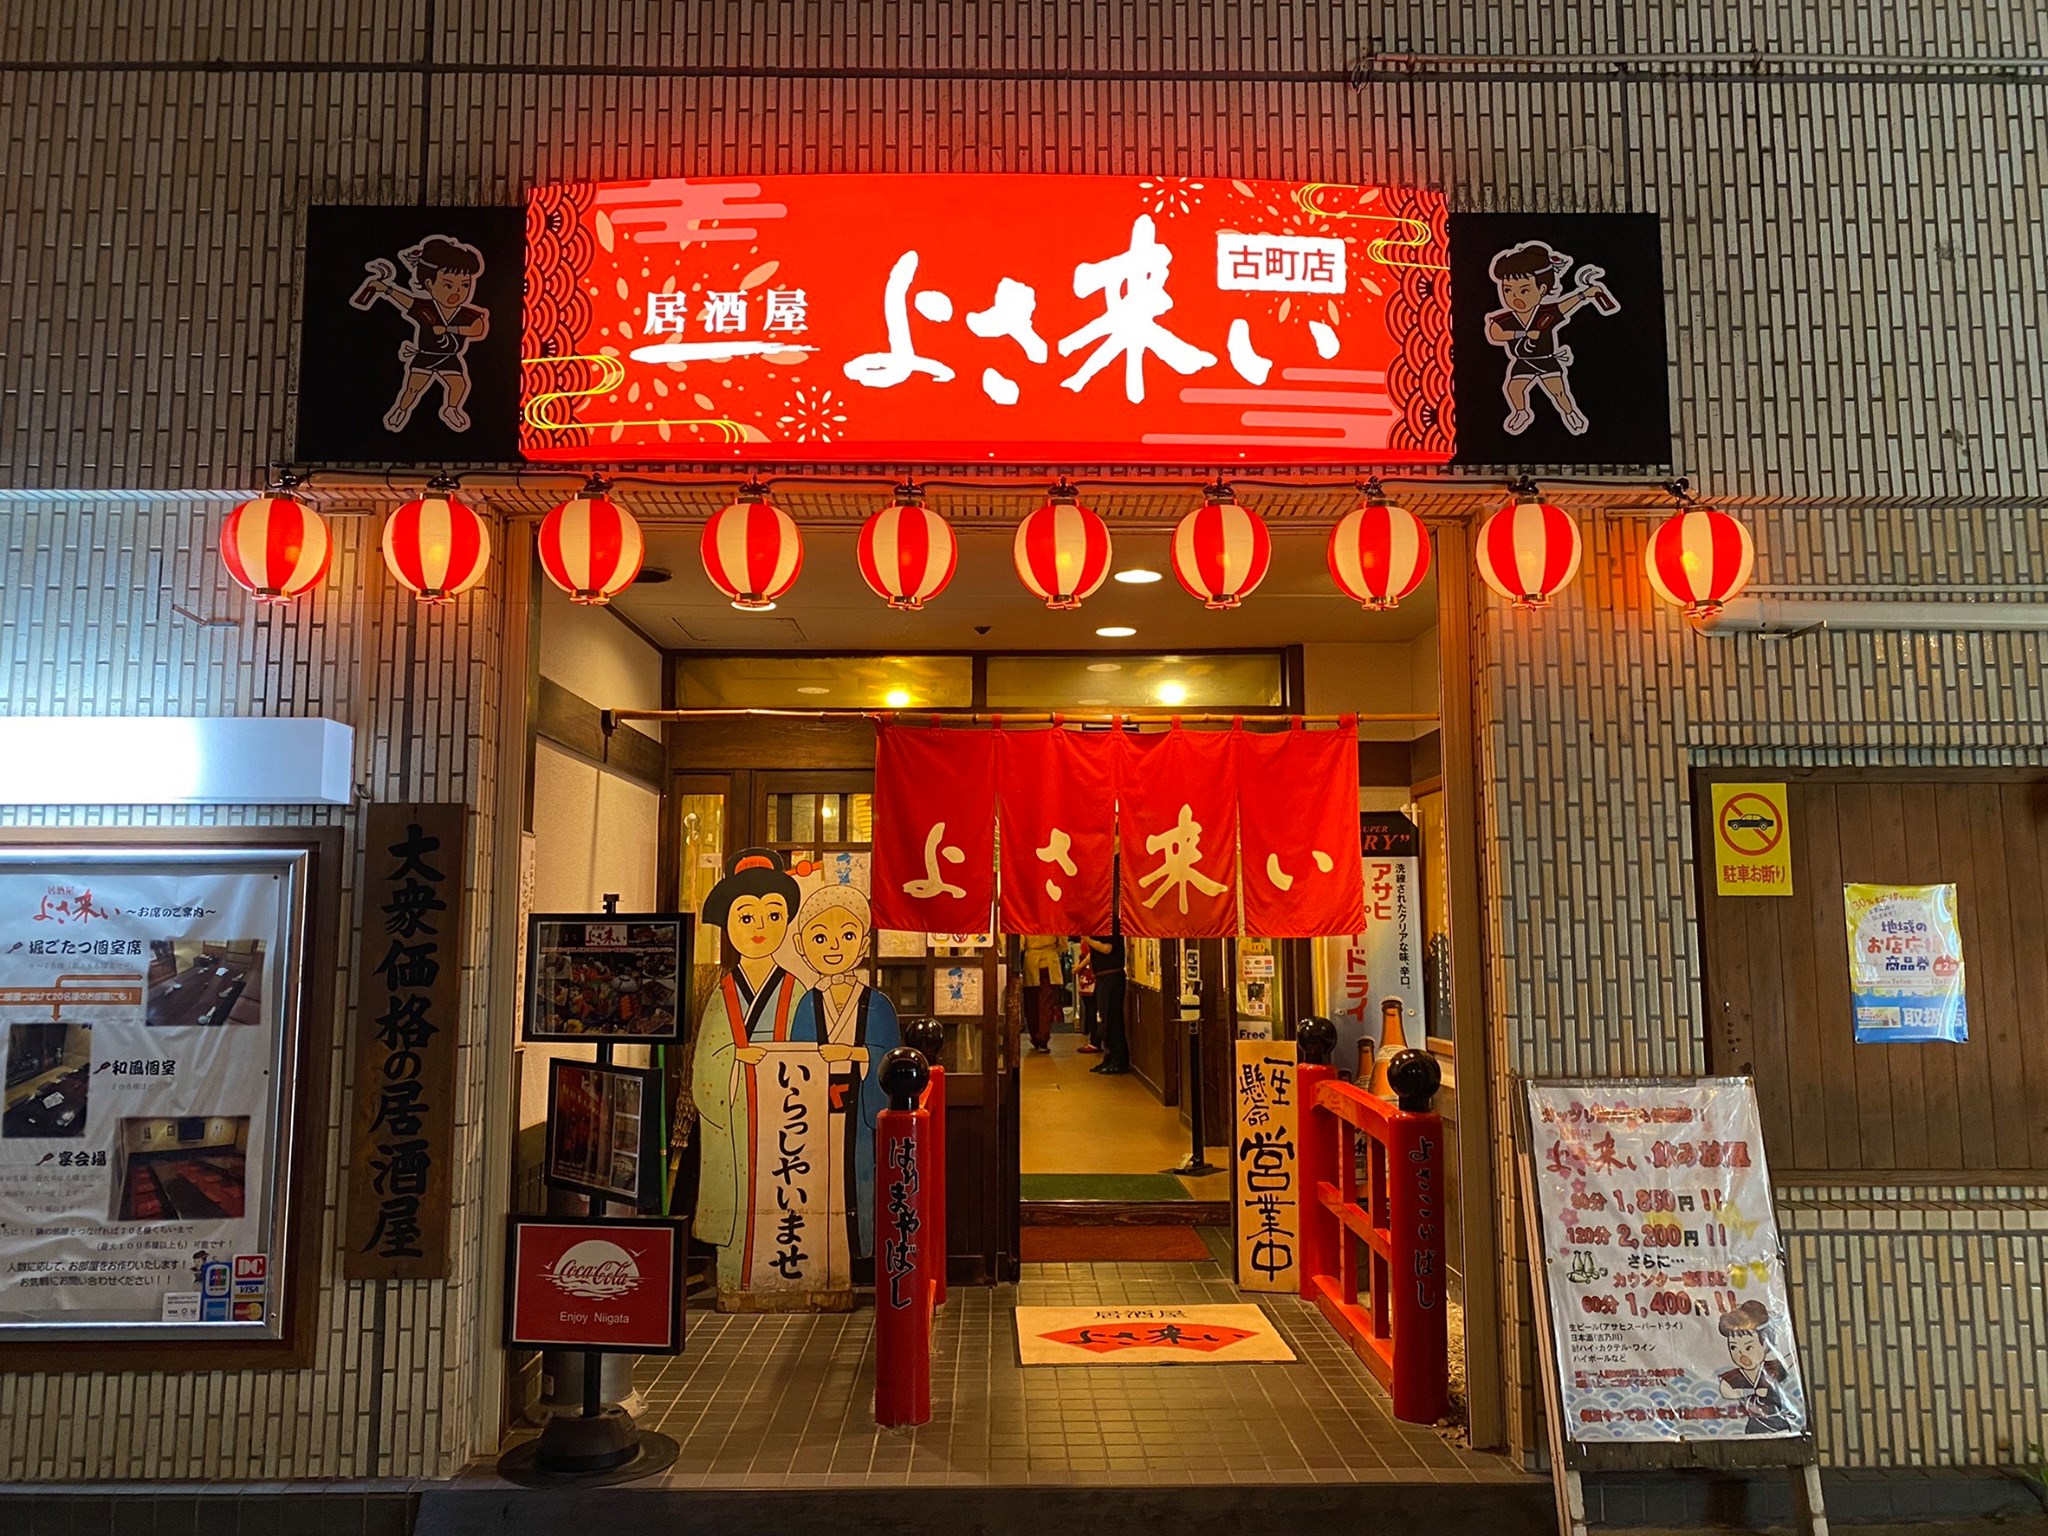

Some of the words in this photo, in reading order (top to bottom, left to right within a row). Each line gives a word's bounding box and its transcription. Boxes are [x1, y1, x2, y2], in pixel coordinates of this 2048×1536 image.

[1228, 245, 1336, 284] 古町店
[643, 289, 810, 334] 居酒屋
[843, 214, 1341, 404] よさ来い
[1360, 825, 1389, 834] UPER
[903, 803, 1334, 915] よさ来い
[1722, 864, 1786, 884] 駐車お断り
[33, 889, 121, 924] よさ来い
[1371, 863, 1393, 920] アサヒ
[1881, 919, 1928, 934] 地域の
[362, 823, 447, 1259] 大衆価格の居酒屋
[1239, 1029, 1266, 1040] Free
[112, 1060, 176, 1076] 和風個室
[58, 1151, 107, 1167] 宴会場
[1239, 1125, 1296, 1283] 営業中
[885, 1136, 921, 1309] はりまやばし
[1408, 1135, 1437, 1310] よさこいばし
[1566, 1225, 1612, 1246] 120分
[560, 1259, 633, 1286] Coca-Cola
[559, 1310, 589, 1325] Enjoy
[593, 1312, 630, 1326] Niigata
